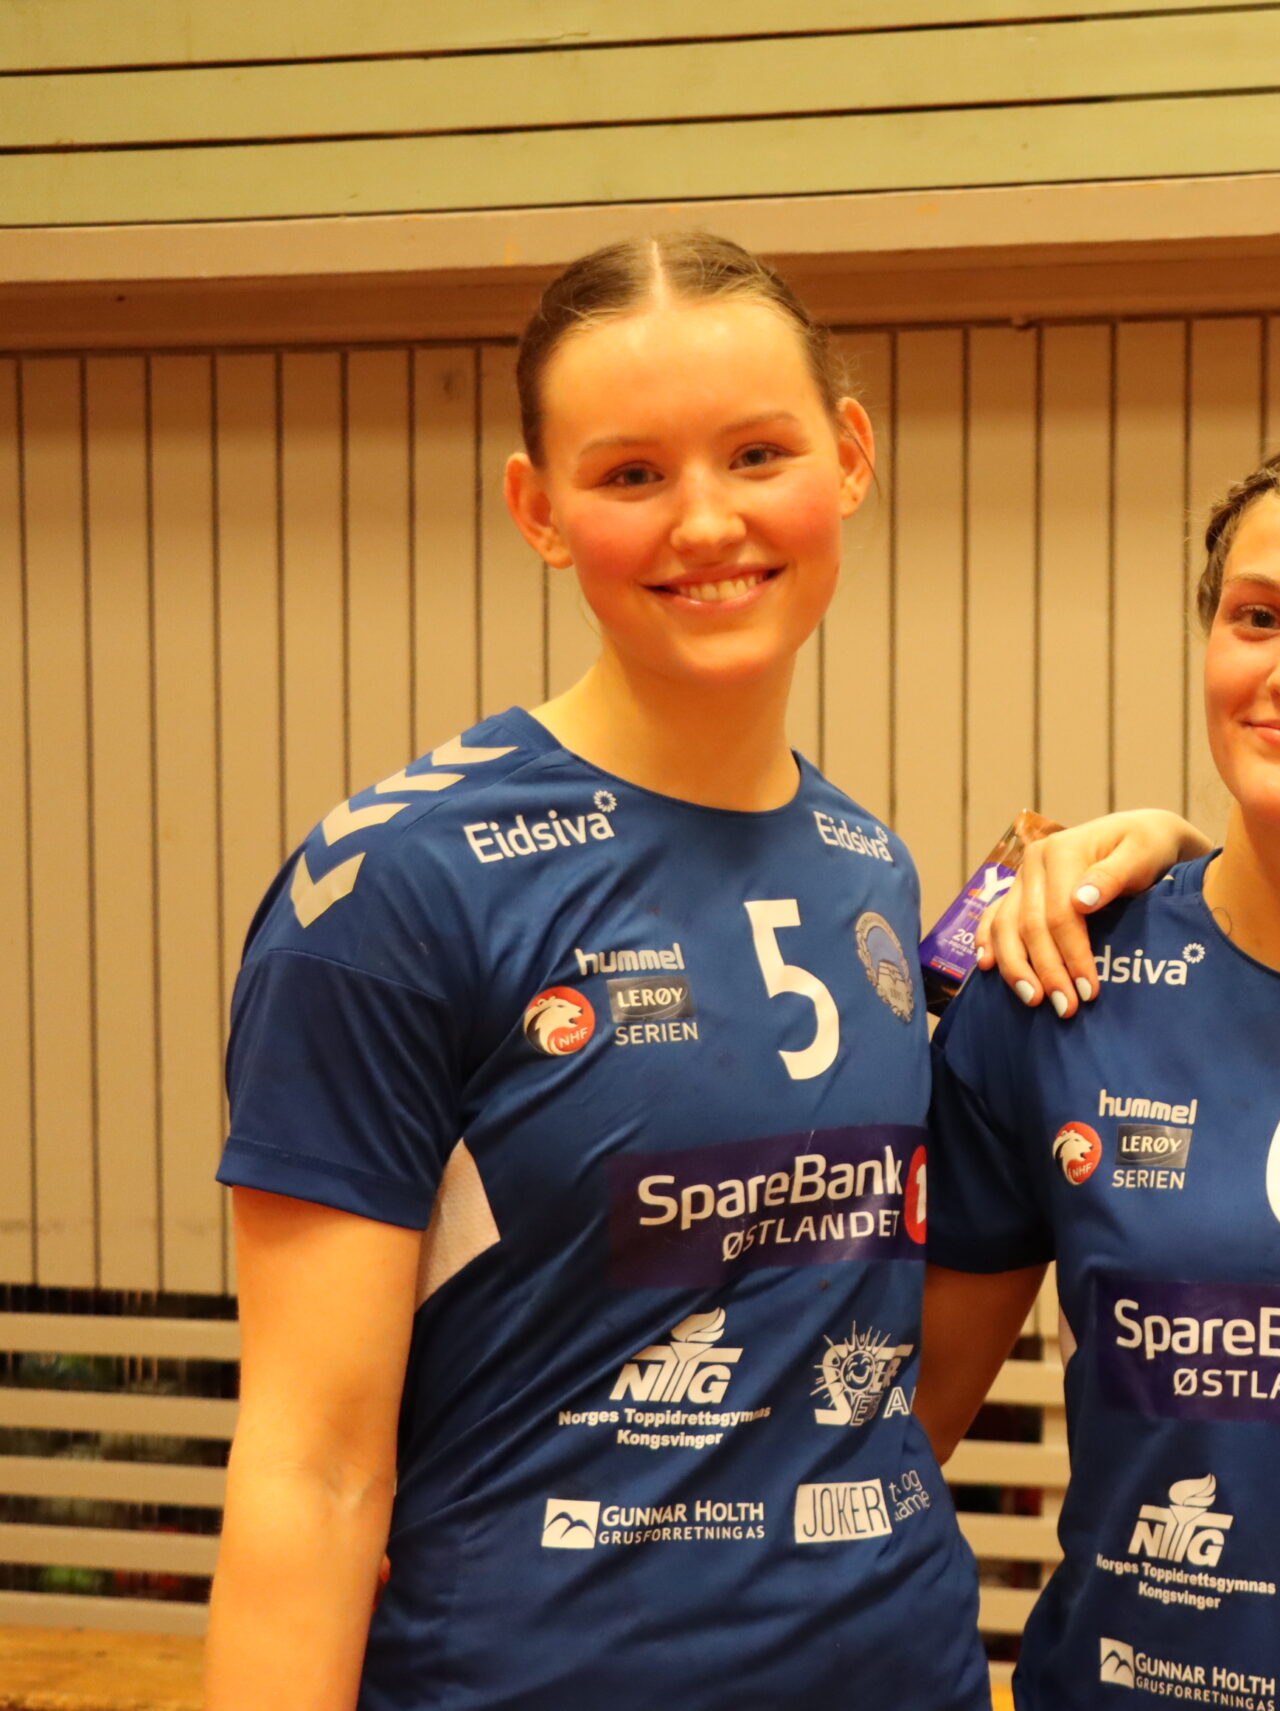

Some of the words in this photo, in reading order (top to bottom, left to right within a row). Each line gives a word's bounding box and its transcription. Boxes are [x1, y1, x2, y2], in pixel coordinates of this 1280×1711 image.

[463, 810, 615, 864] Eidsiva
[813, 811, 894, 862] Eidsiva
[575, 943, 685, 976] hummel
[1094, 945, 1188, 986] dsiva
[617, 987, 683, 1008] LERØY
[745, 899, 840, 1079] 5
[559, 1027, 588, 1048] NHF
[614, 1022, 698, 1046] SERIEN
[1099, 1091, 1198, 1125] hummel
[1121, 1135, 1182, 1153] LERØY
[1072, 1162, 1093, 1177] NHF
[1112, 1169, 1185, 1190] SERIEN
[637, 1145, 903, 1230] SpareBank
[916, 1164, 927, 1224] 1
[722, 1209, 900, 1262] ØSTLANDET
[609, 1342, 744, 1404] NTG
[558, 1410, 619, 1426] Norges
[617, 1429, 723, 1450] Kongsvinger
[602, 1503, 688, 1527] GUNNAR
[695, 1500, 764, 1522] HOLTH
[803, 1486, 887, 1537] JOKER
[902, 1470, 923, 1492] og
[1128, 1504, 1234, 1567] NTG
[1142, 1562, 1276, 1595] Toppidrettsgymnas
[1138, 1581, 1221, 1610] Kongsvinger
[1135, 1652, 1206, 1685] GUNNAR
[1212, 1666, 1275, 1696] HOLTH
